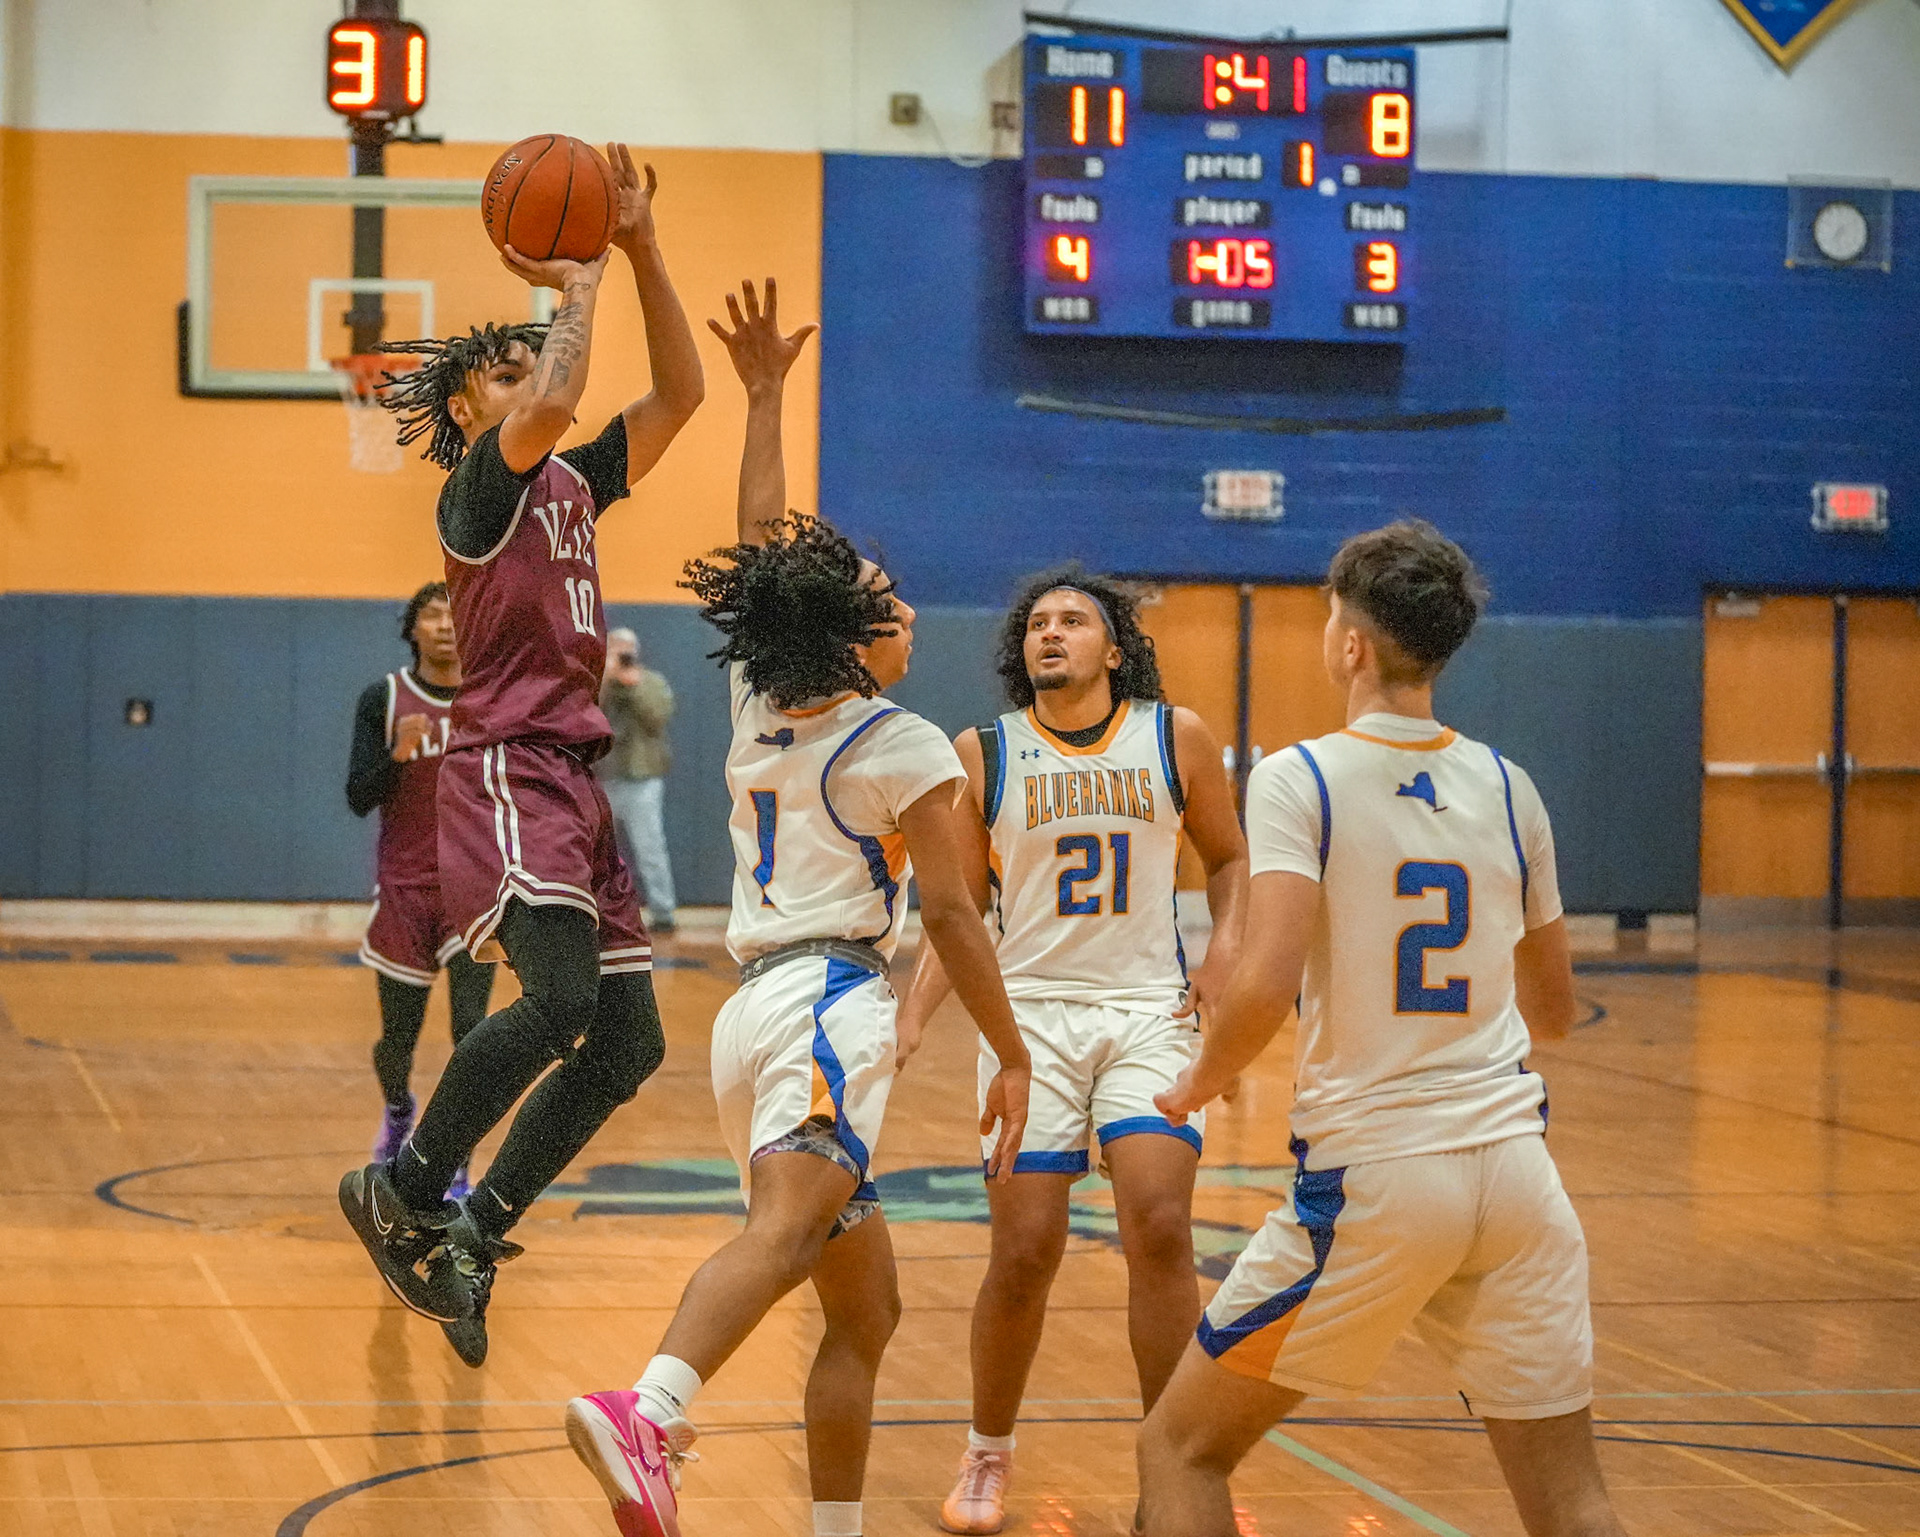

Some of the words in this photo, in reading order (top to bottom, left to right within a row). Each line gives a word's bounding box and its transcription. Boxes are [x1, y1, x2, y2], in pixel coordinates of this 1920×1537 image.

[332, 29, 424, 104] 31
[1203, 53, 1306, 113] 1:41
[1071, 85, 1126, 147] 11
[1369, 92, 1411, 158] 8
[1299, 141, 1314, 188] 1
[1056, 234, 1090, 282] 4
[1367, 241, 1398, 292] 3
[565, 577, 597, 637] 10
[1024, 768, 1155, 831] BLUEHAWKS
[748, 788, 779, 908] 1
[1055, 831, 1132, 917] 21
[1393, 857, 1472, 1017] 2
